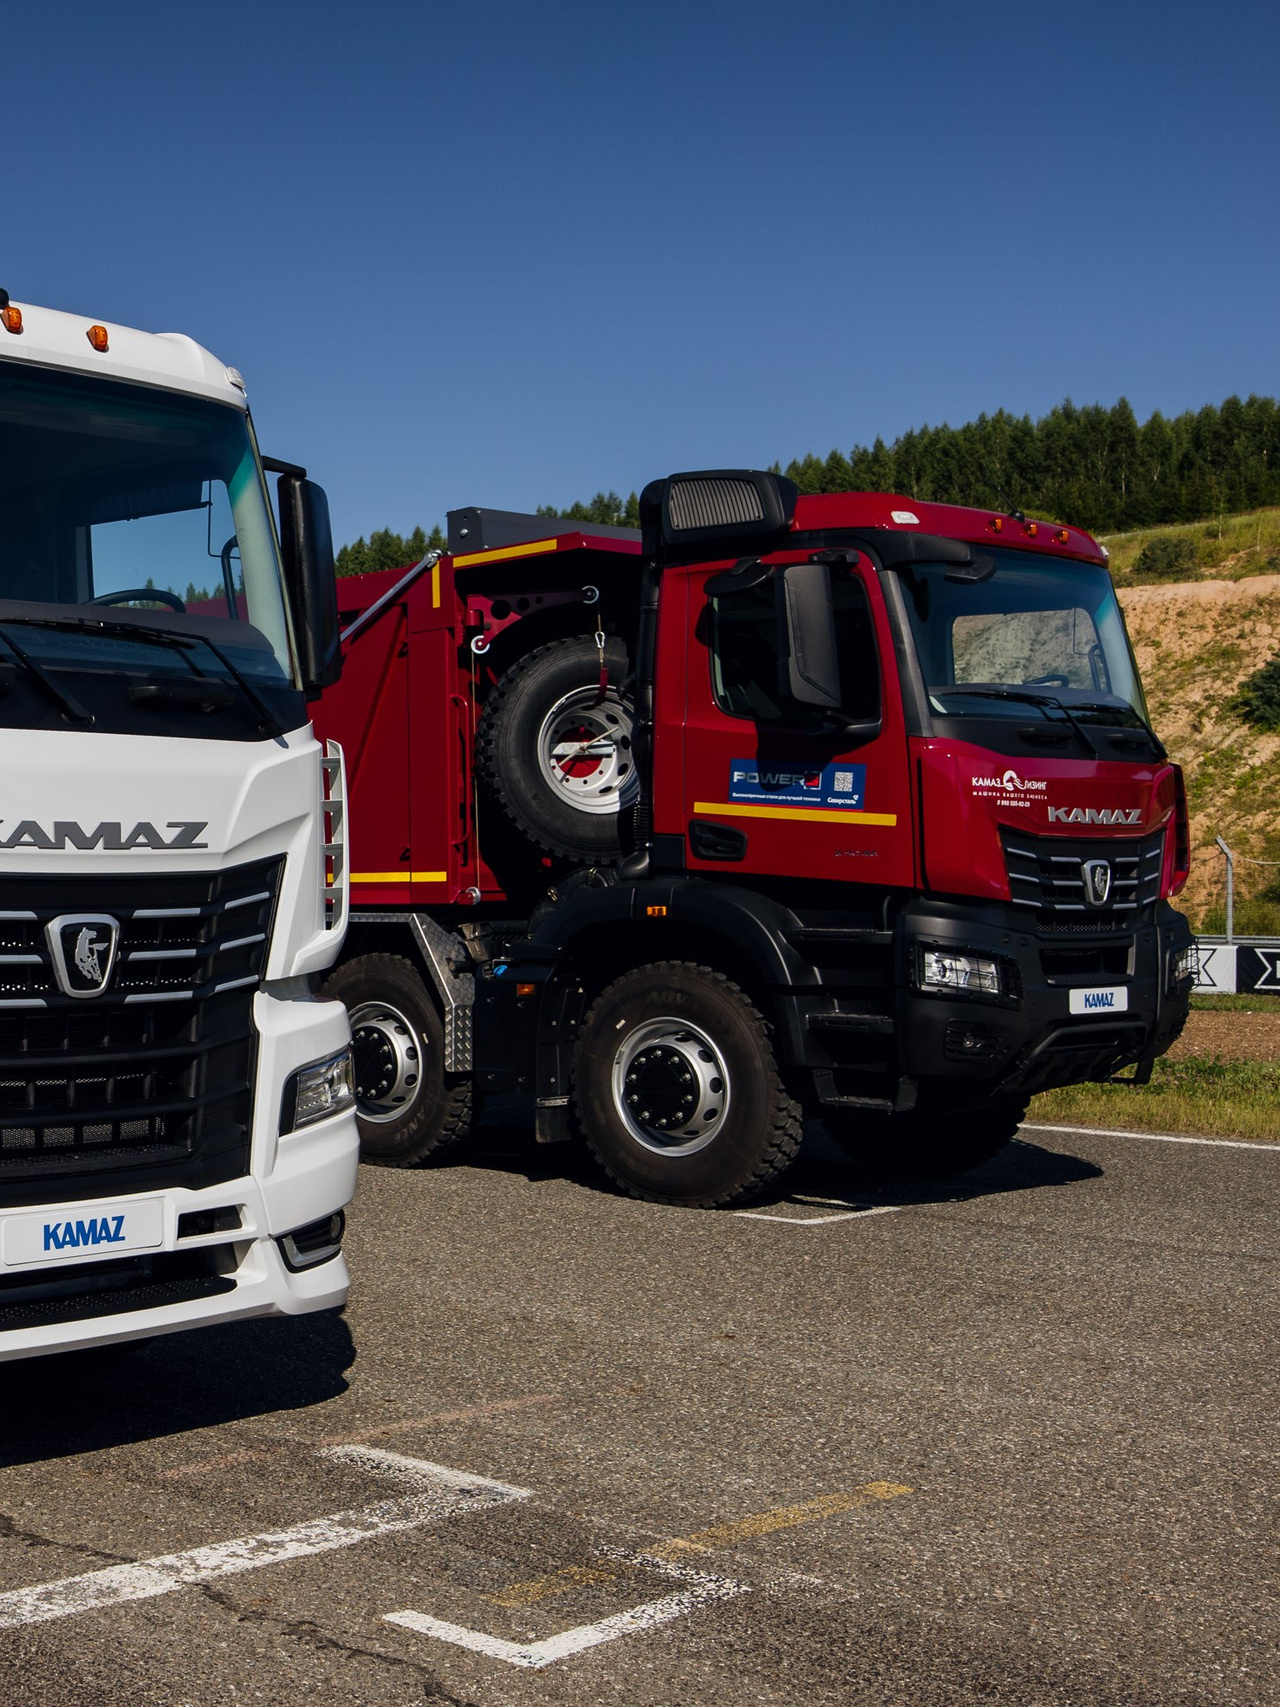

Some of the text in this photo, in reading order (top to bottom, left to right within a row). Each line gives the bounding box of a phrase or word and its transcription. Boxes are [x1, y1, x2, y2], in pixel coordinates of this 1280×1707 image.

[733, 771, 804, 786] POWER
[971, 777, 1047, 790] КАМАЗ ЛИЗИНГ
[1047, 806, 1143, 825] KAMAZ
[1084, 992, 1115, 1008] KAMAZ
[43, 1215, 126, 1251] KAMAZ
